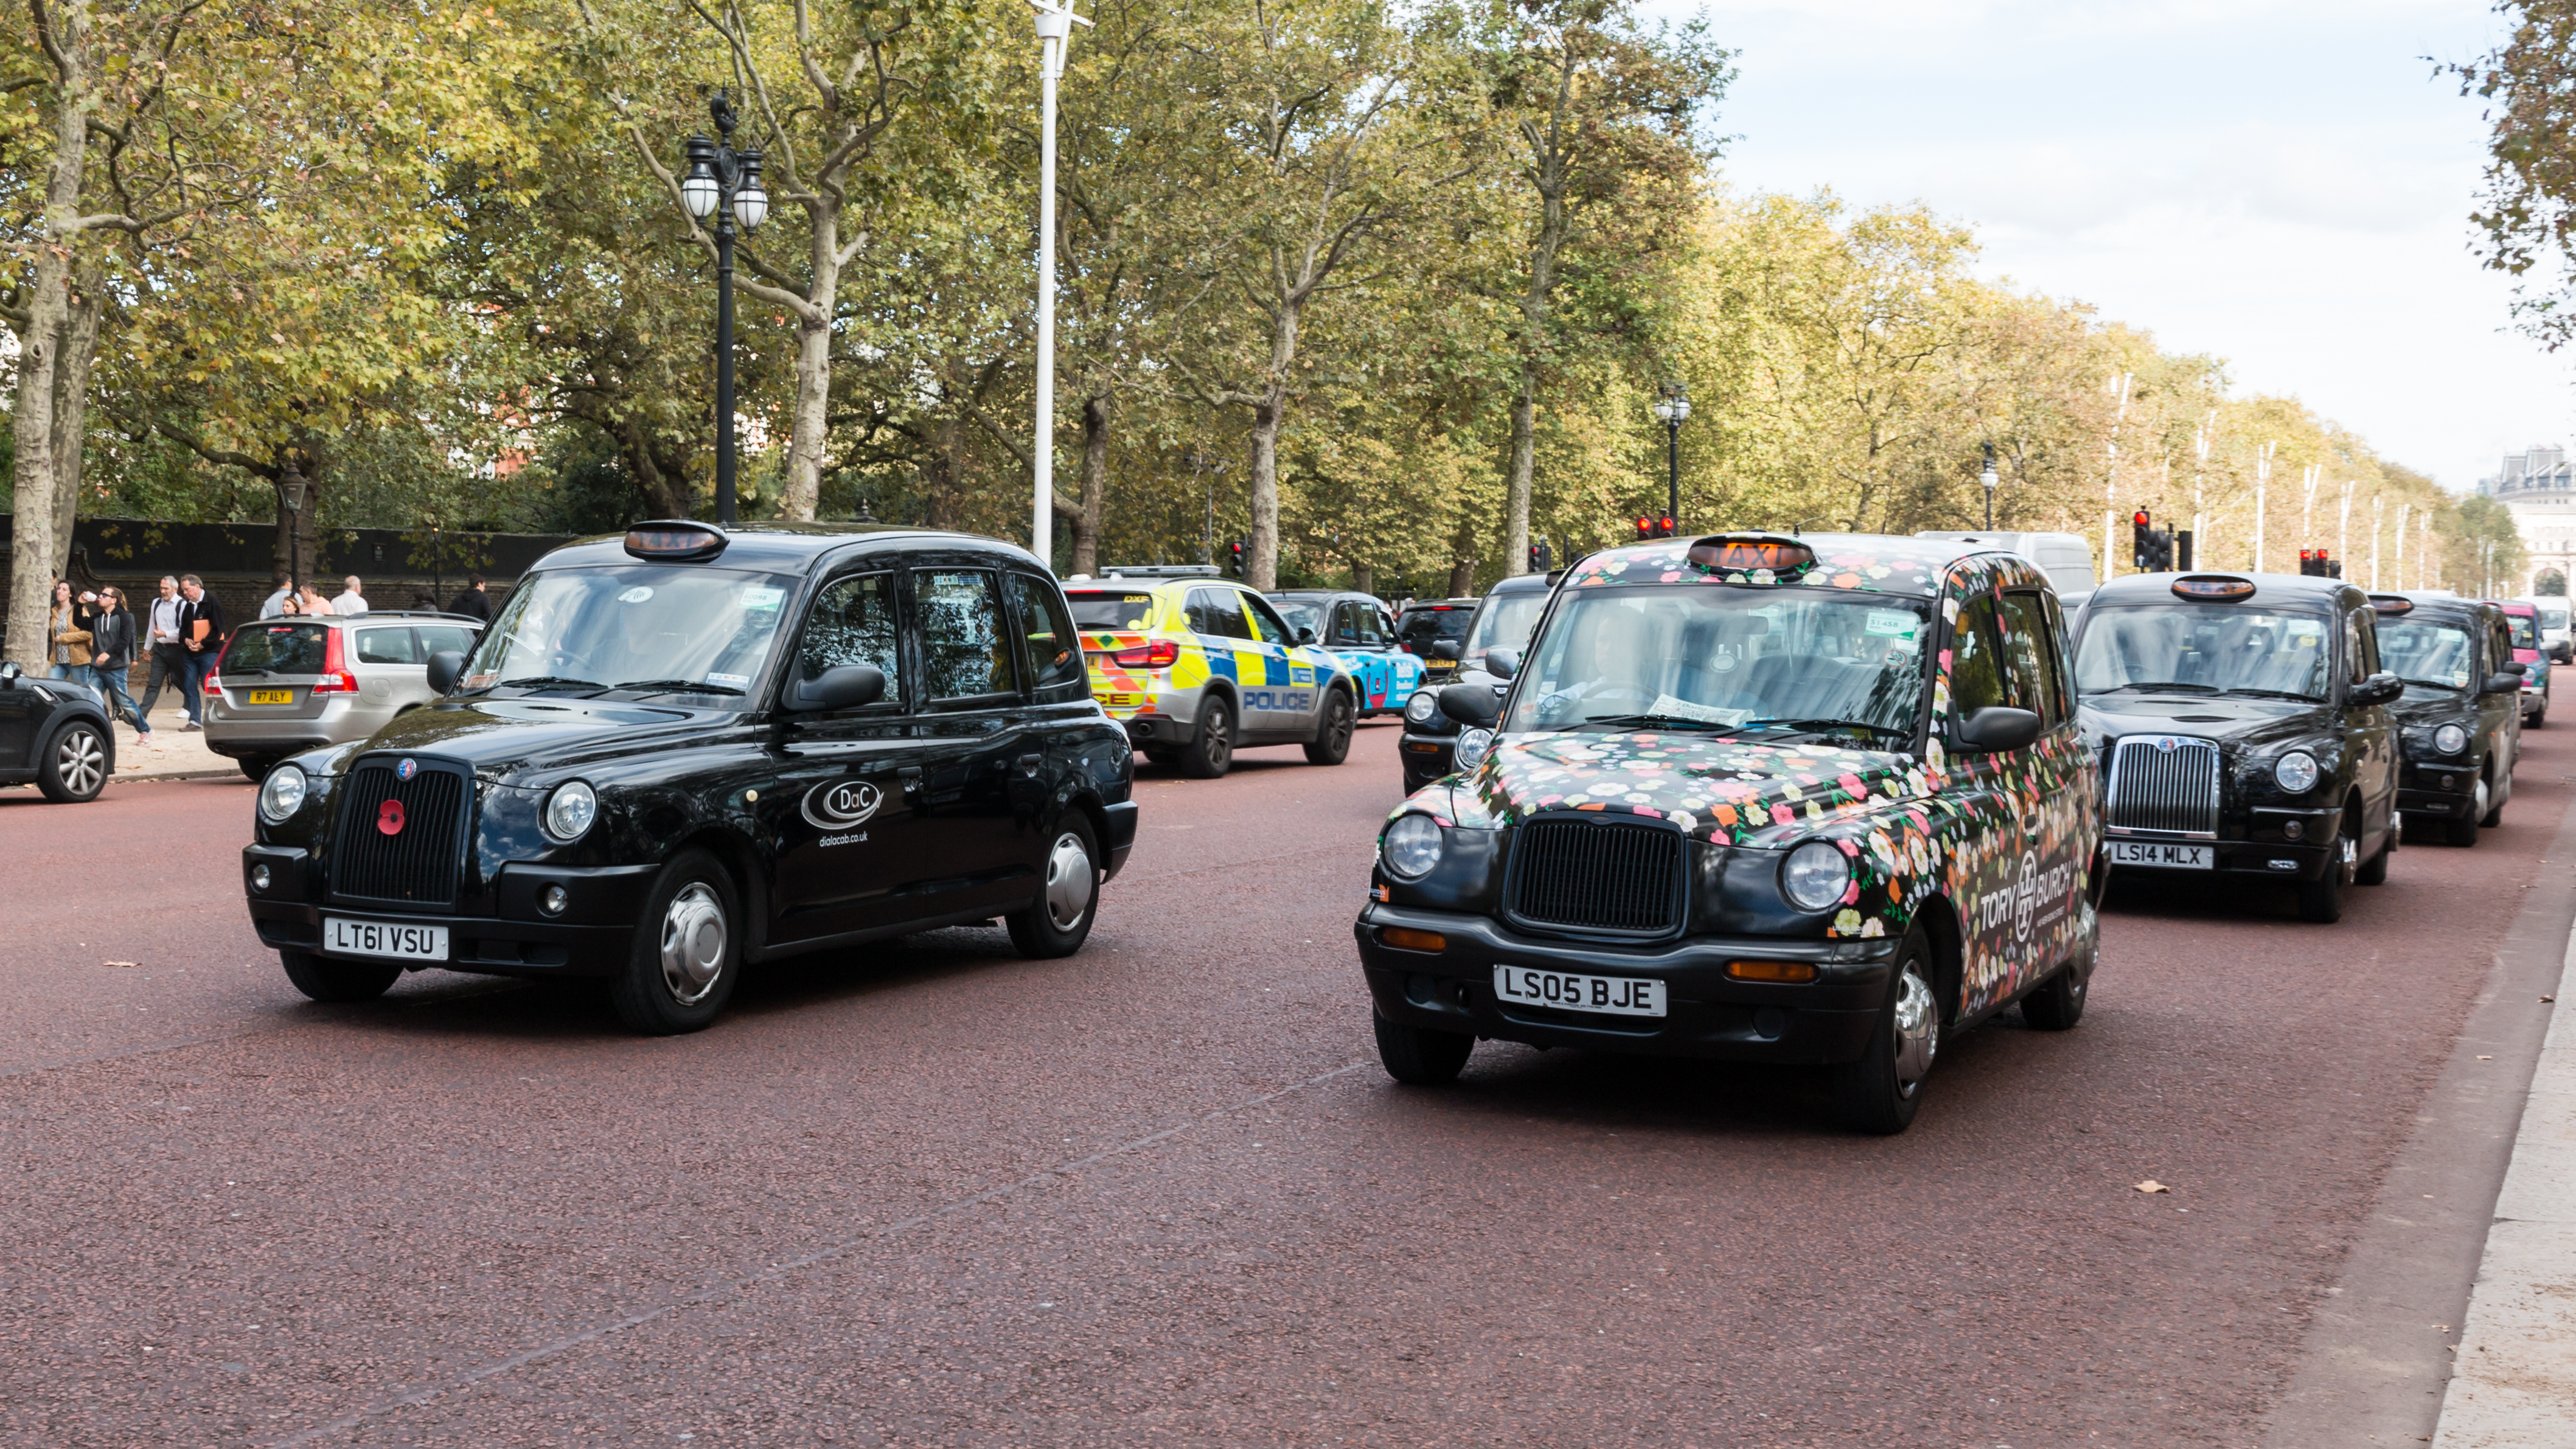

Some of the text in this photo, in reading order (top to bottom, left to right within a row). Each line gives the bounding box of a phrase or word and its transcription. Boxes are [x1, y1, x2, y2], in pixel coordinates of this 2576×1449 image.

[639, 532, 693, 547] TAXI
[1713, 545, 1783, 565] TAXI
[1124, 595, 1150, 603] DXF
[1870, 619, 1898, 628] 51458
[256, 692, 267, 702] R7
[1242, 692, 1309, 711] POLICE
[840, 786, 869, 810] DaC
[820, 830, 868, 847] dialacab.co.uk
[2117, 844, 2201, 864] LS14 MLX
[1980, 860, 2072, 931] TORY BURCH
[338, 923, 433, 954] LT61 VSU
[1505, 968, 1652, 1009] LS05 BJE
